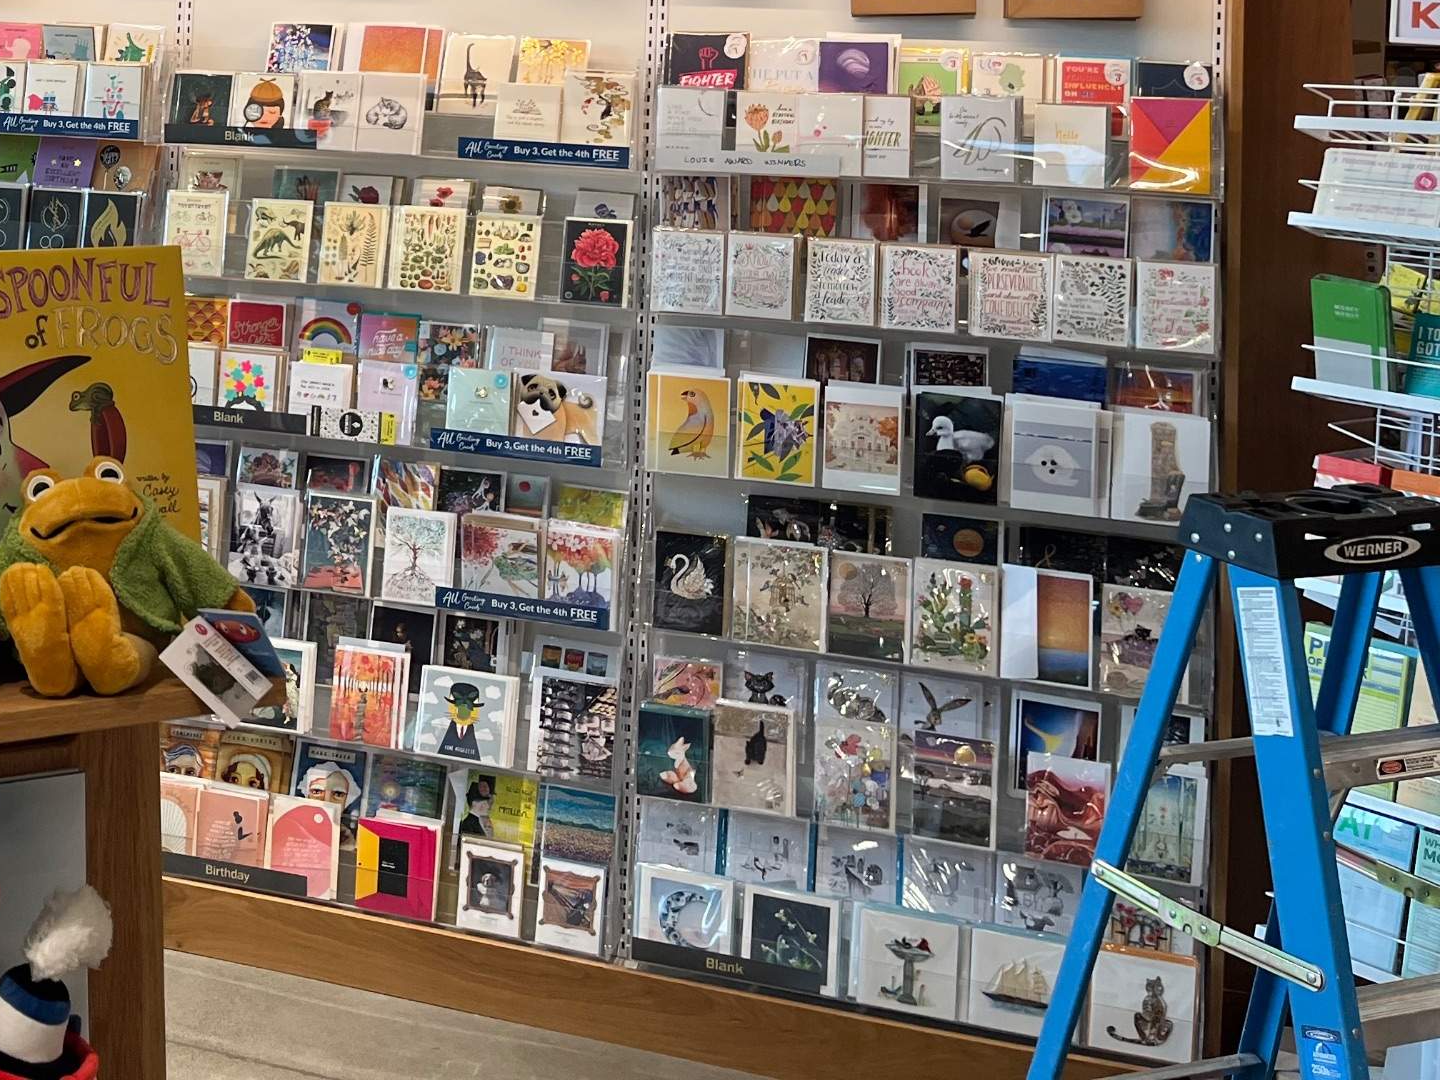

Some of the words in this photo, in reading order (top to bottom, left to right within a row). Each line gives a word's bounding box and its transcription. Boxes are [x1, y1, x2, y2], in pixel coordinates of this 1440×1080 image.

[679, 72, 736, 88] FIGHTER
[43, 120, 57, 129] Buy
[65, 121, 79, 129] Get
[80, 121, 92, 130] the
[93, 122, 106, 130] 4th
[108, 121, 130, 132] FREE
[224, 129, 255, 142] Blank
[513, 146, 530, 157] Buy
[541, 147, 557, 156] Get
[558, 148, 573, 157] the
[574, 149, 590, 158] 4th
[592, 149, 619, 160] FREE
[25, 316, 48, 350] of
[52, 304, 179, 366] FROGS
[509, 347, 542, 359] THINK
[213, 411, 244, 424] Blank
[486, 438, 502, 450] Buy
[513, 442, 529, 451] Get
[531, 443, 545, 453] the
[546, 445, 561, 455] 4th
[564, 446, 592, 458] FREE
[142, 484, 180, 501] Casey
[1343, 540, 1403, 558] WERNER
[491, 599, 508, 610] Buy
[518, 603, 535, 612] Get
[536, 604, 551, 615] the
[553, 606, 568, 617] 4th
[570, 608, 598, 620] FREE
[205, 864, 250, 882] Birthday
[705, 957, 745, 975] Blank
